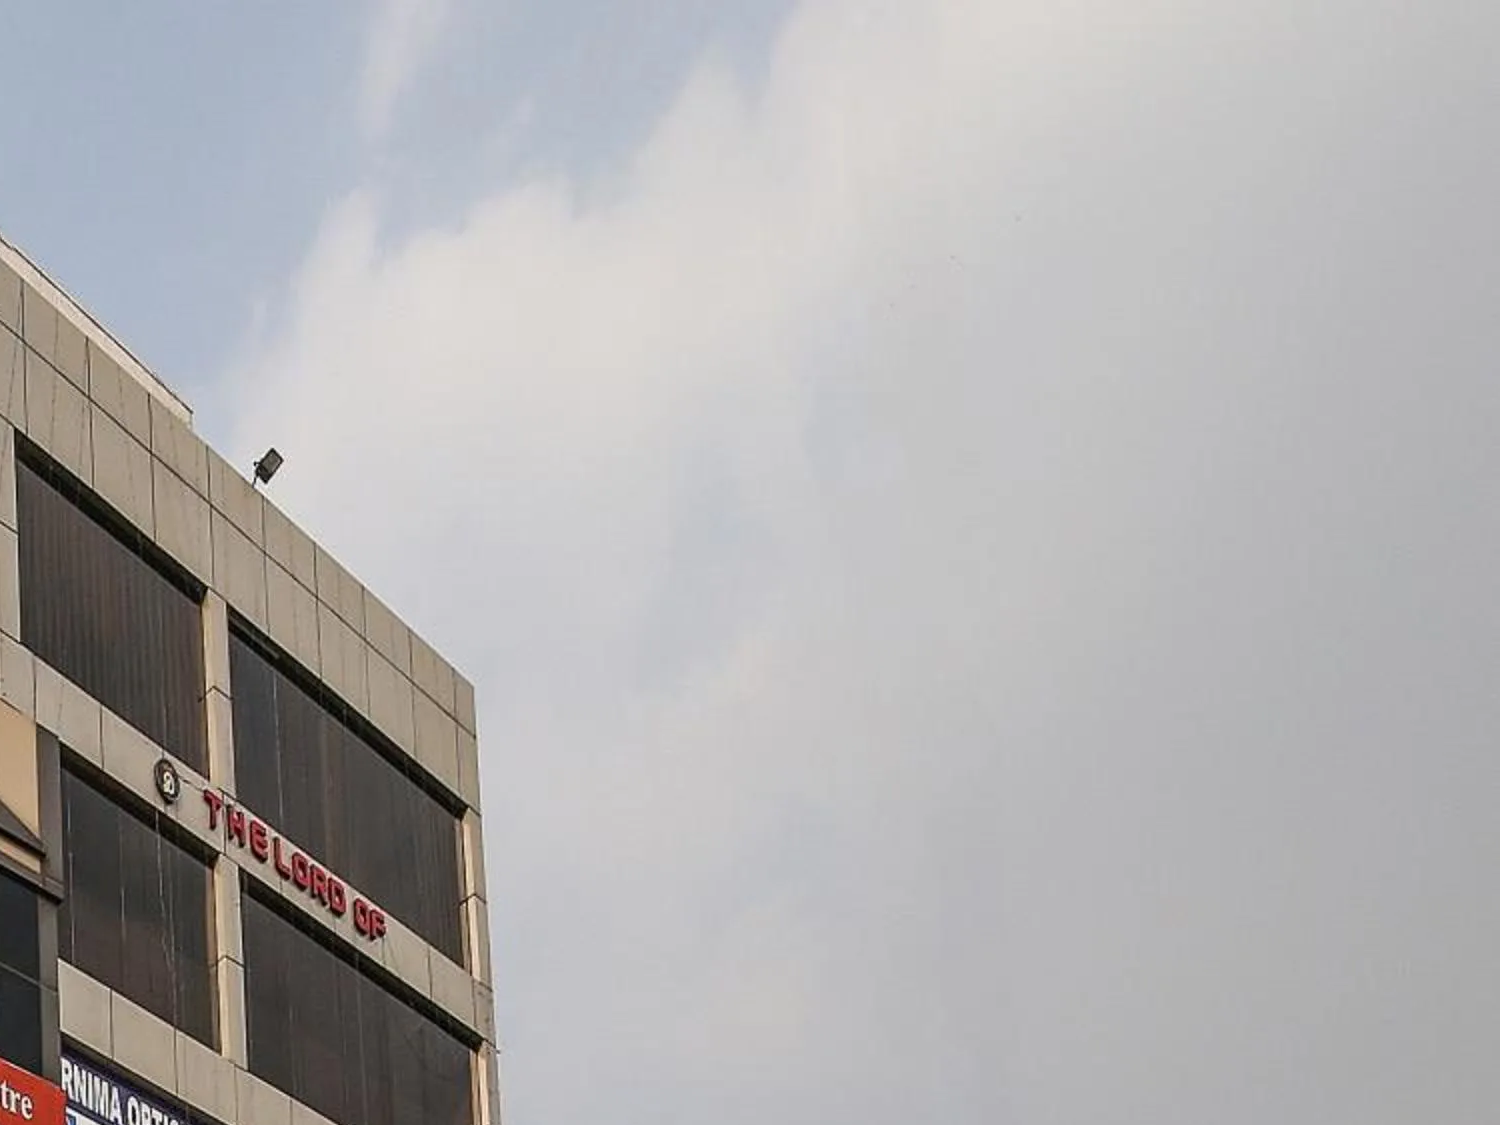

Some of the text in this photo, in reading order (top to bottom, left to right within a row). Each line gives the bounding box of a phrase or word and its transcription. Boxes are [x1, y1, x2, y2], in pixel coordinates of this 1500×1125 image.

[202, 788, 387, 942] THE LORD OF
